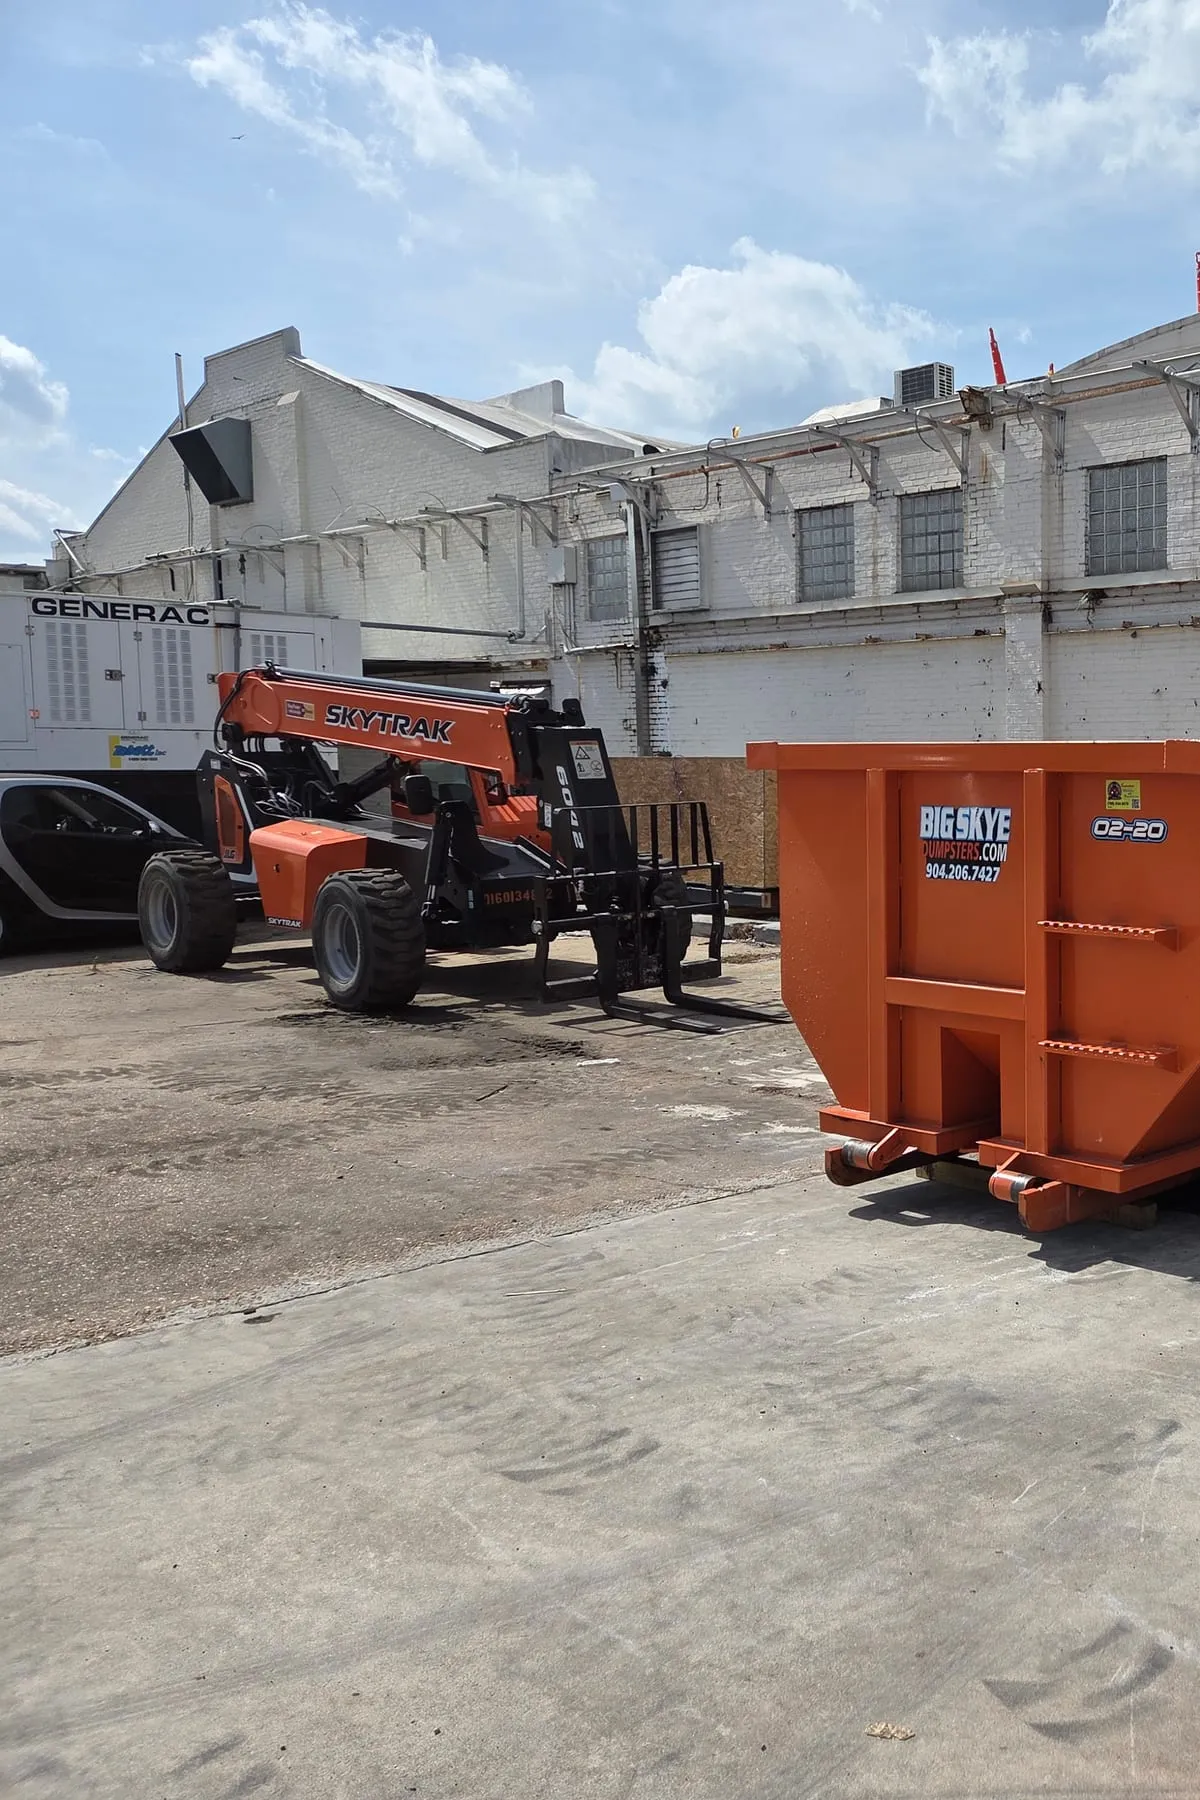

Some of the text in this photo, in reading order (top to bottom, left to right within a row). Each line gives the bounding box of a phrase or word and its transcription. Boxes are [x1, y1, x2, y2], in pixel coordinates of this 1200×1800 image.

[31, 597, 210, 625] GENERAC
[324, 703, 456, 745] SKYTRAK
[1092, 818, 1166, 840] 02-20
[922, 841, 1008, 862] DUMPSTERS.COM
[925, 863, 1001, 882] 904.206.7427
[267, 917, 302, 928] SKYTRAK
